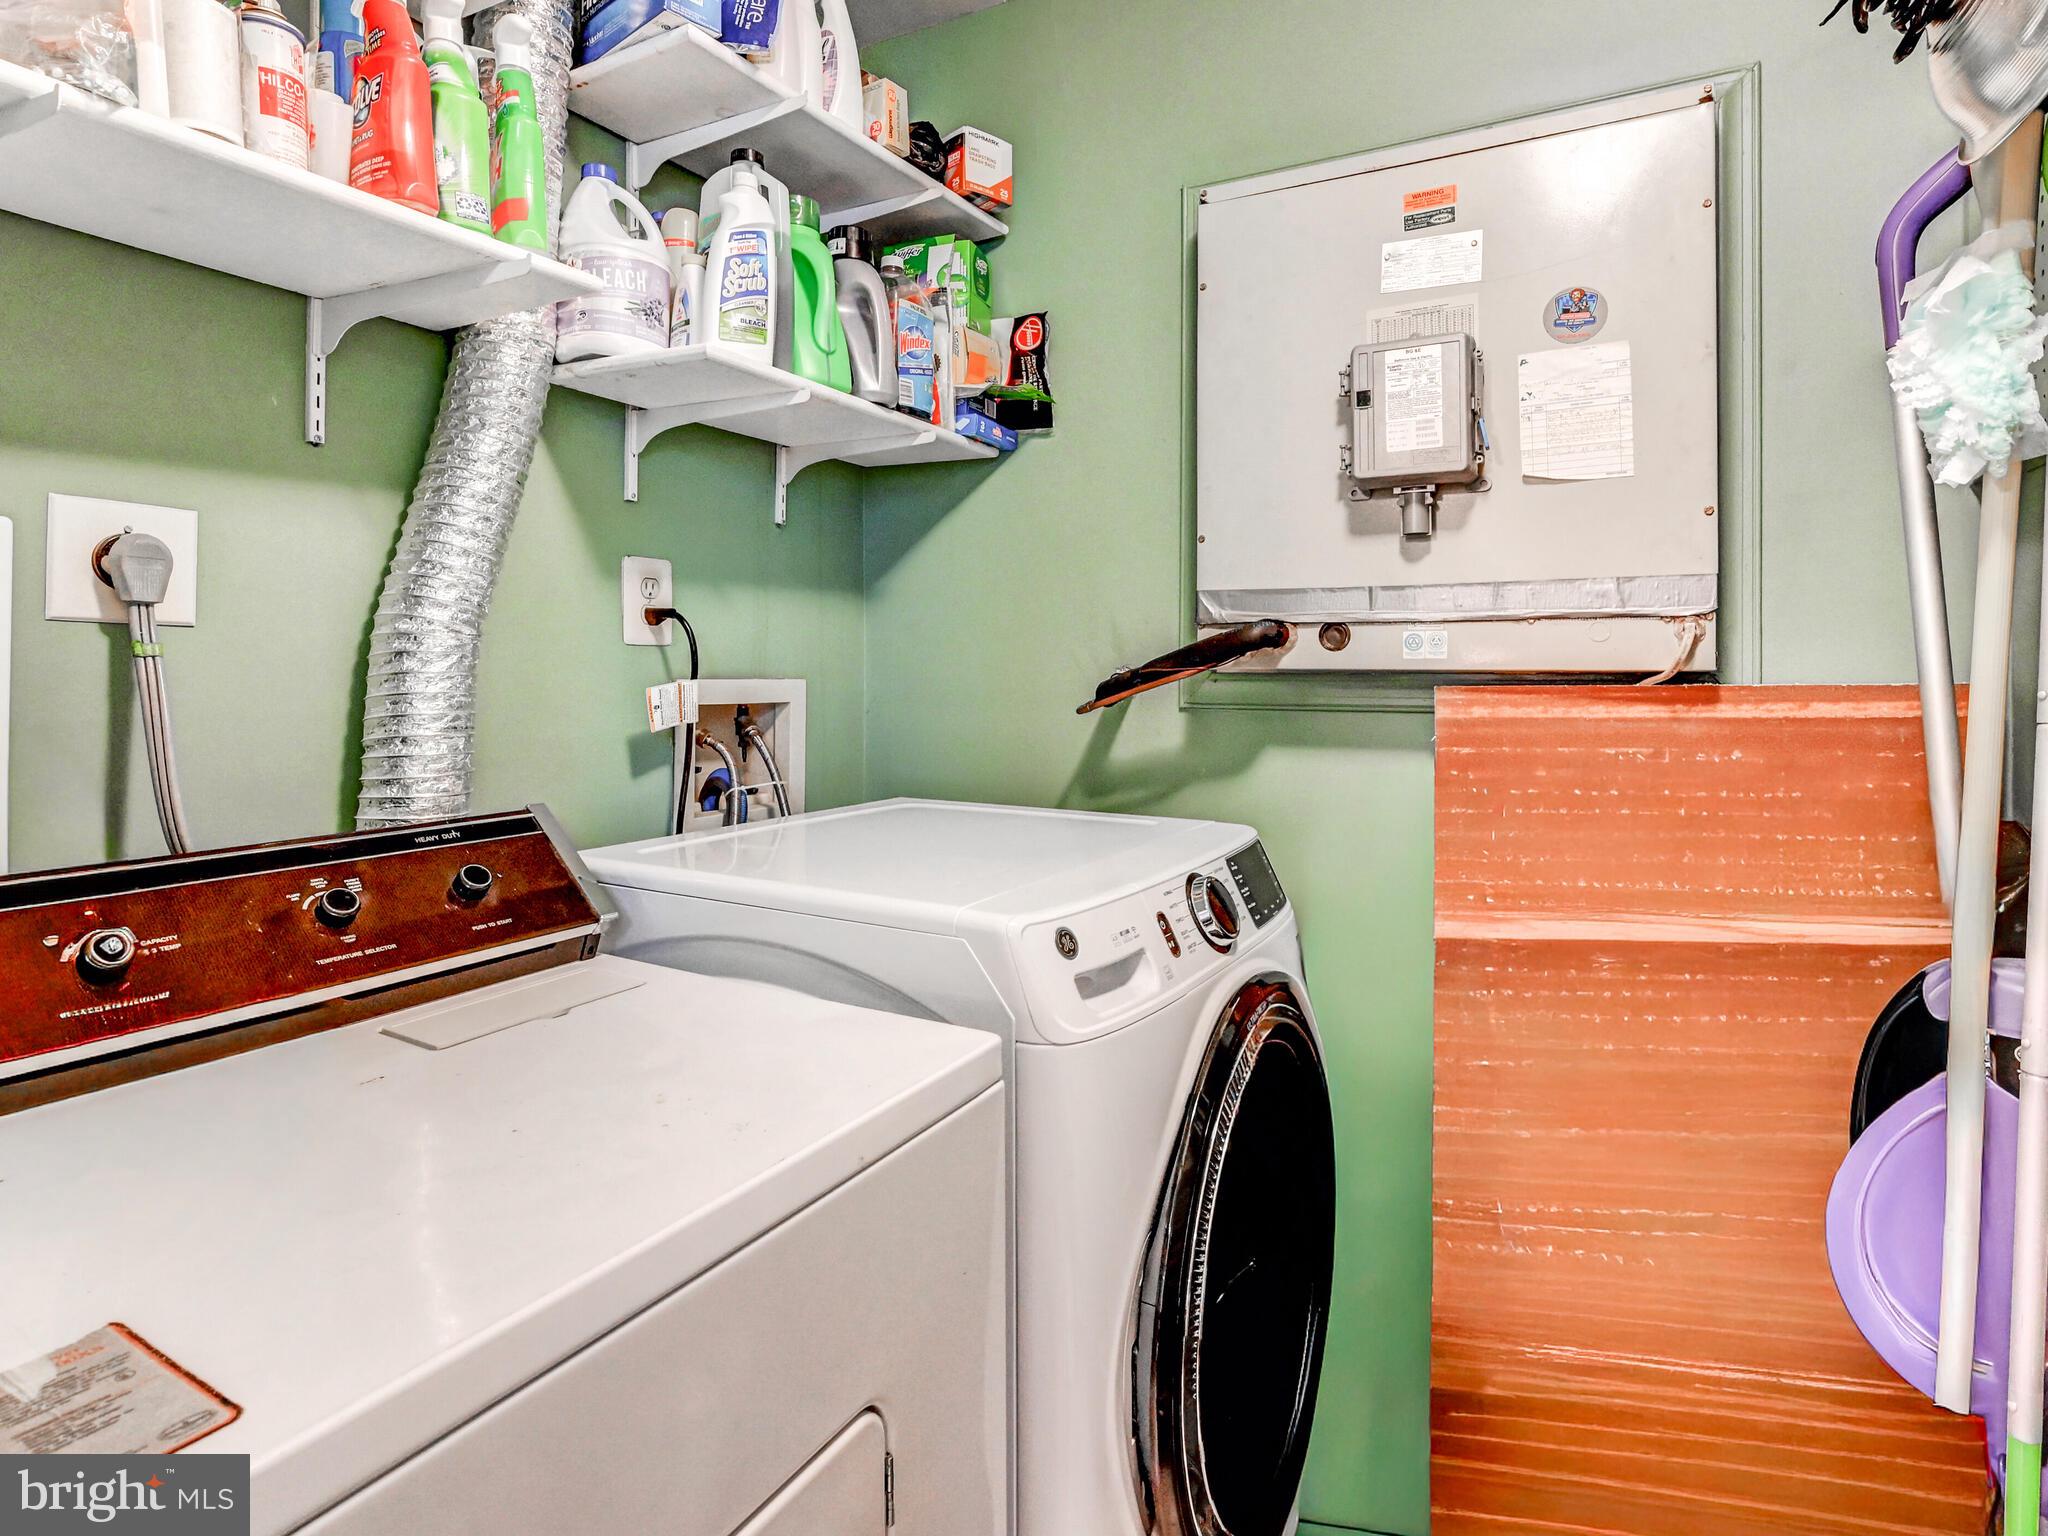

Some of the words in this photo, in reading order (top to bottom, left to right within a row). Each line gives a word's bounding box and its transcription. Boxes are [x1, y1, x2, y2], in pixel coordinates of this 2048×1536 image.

[751, 0, 766, 23] are
[352, 77, 382, 116] OLVE
[968, 131, 1000, 147] HIGHMARK
[1412, 188, 1445, 199] WARNING
[737, 244, 757, 252] WIPE
[893, 246, 922, 260] wiffer
[728, 257, 763, 278] Soft
[582, 267, 647, 292] LEACH
[722, 272, 766, 298] Scrub
[740, 317, 766, 328] BLEACH
[900, 330, 931, 356] Windex
[414, 835, 440, 844] HEAVY
[441, 829, 461, 840] DUTY
[471, 923, 488, 932] PUSH
[496, 918, 513, 926] START
[140, 934, 178, 947] CAPACITY
[159, 942, 182, 953] TEMP
[315, 951, 364, 966] TEMPERATURE
[364, 943, 398, 956] SELECTOR
